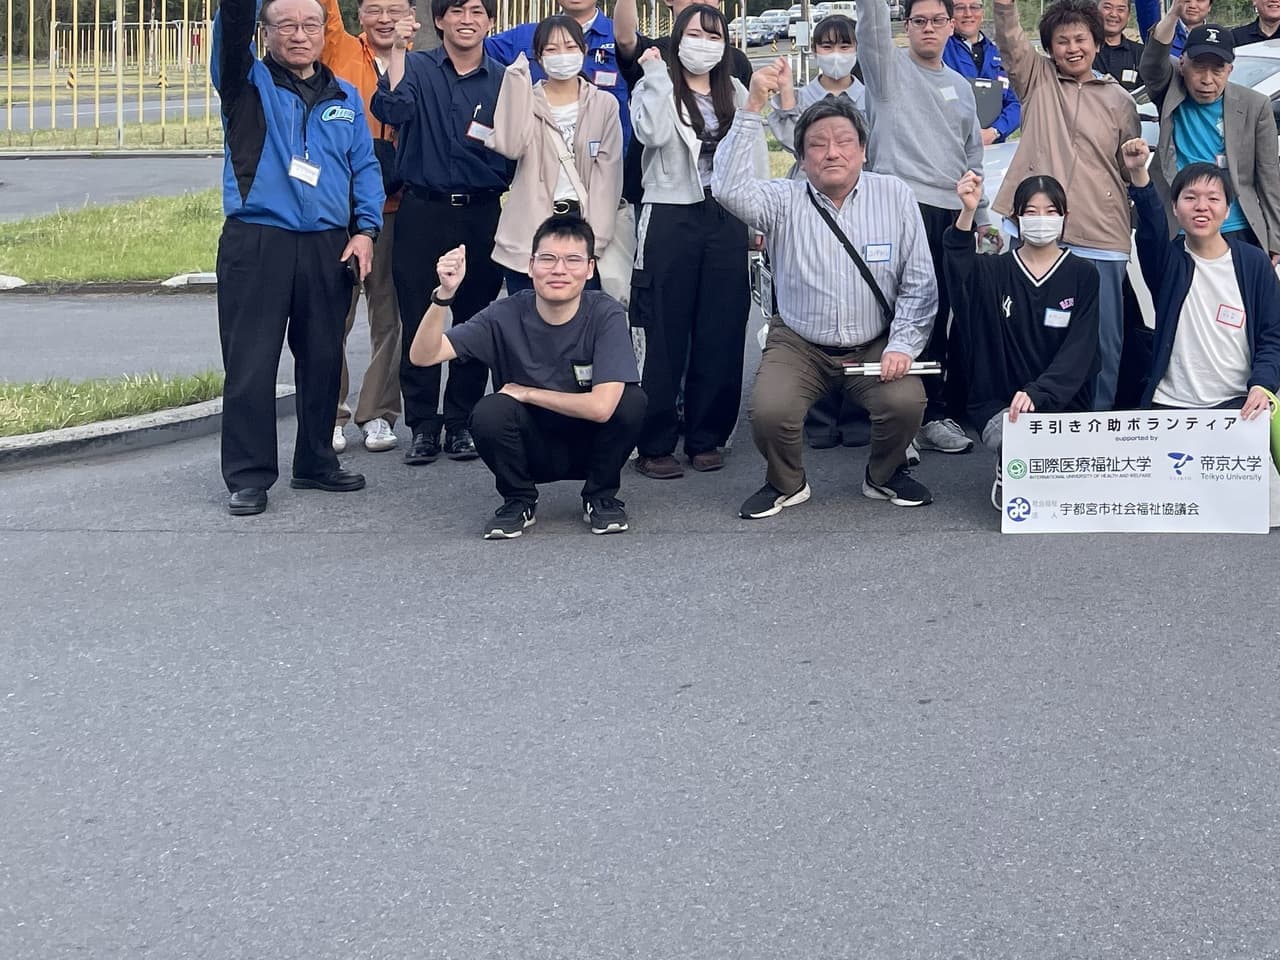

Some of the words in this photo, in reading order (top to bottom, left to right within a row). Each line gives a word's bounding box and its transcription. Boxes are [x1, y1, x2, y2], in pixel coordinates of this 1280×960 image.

[1029, 417, 1237, 434] 手引き介助ボランティア
[1029, 456, 1152, 474] 国際医療福祉大学
[1200, 455, 1262, 472] 帝京大学
[1200, 473, 1225, 481] Teikyo
[1226, 472, 1262, 481] University
[1059, 502, 1200, 516] 宇都宮市社会福祉協議会
